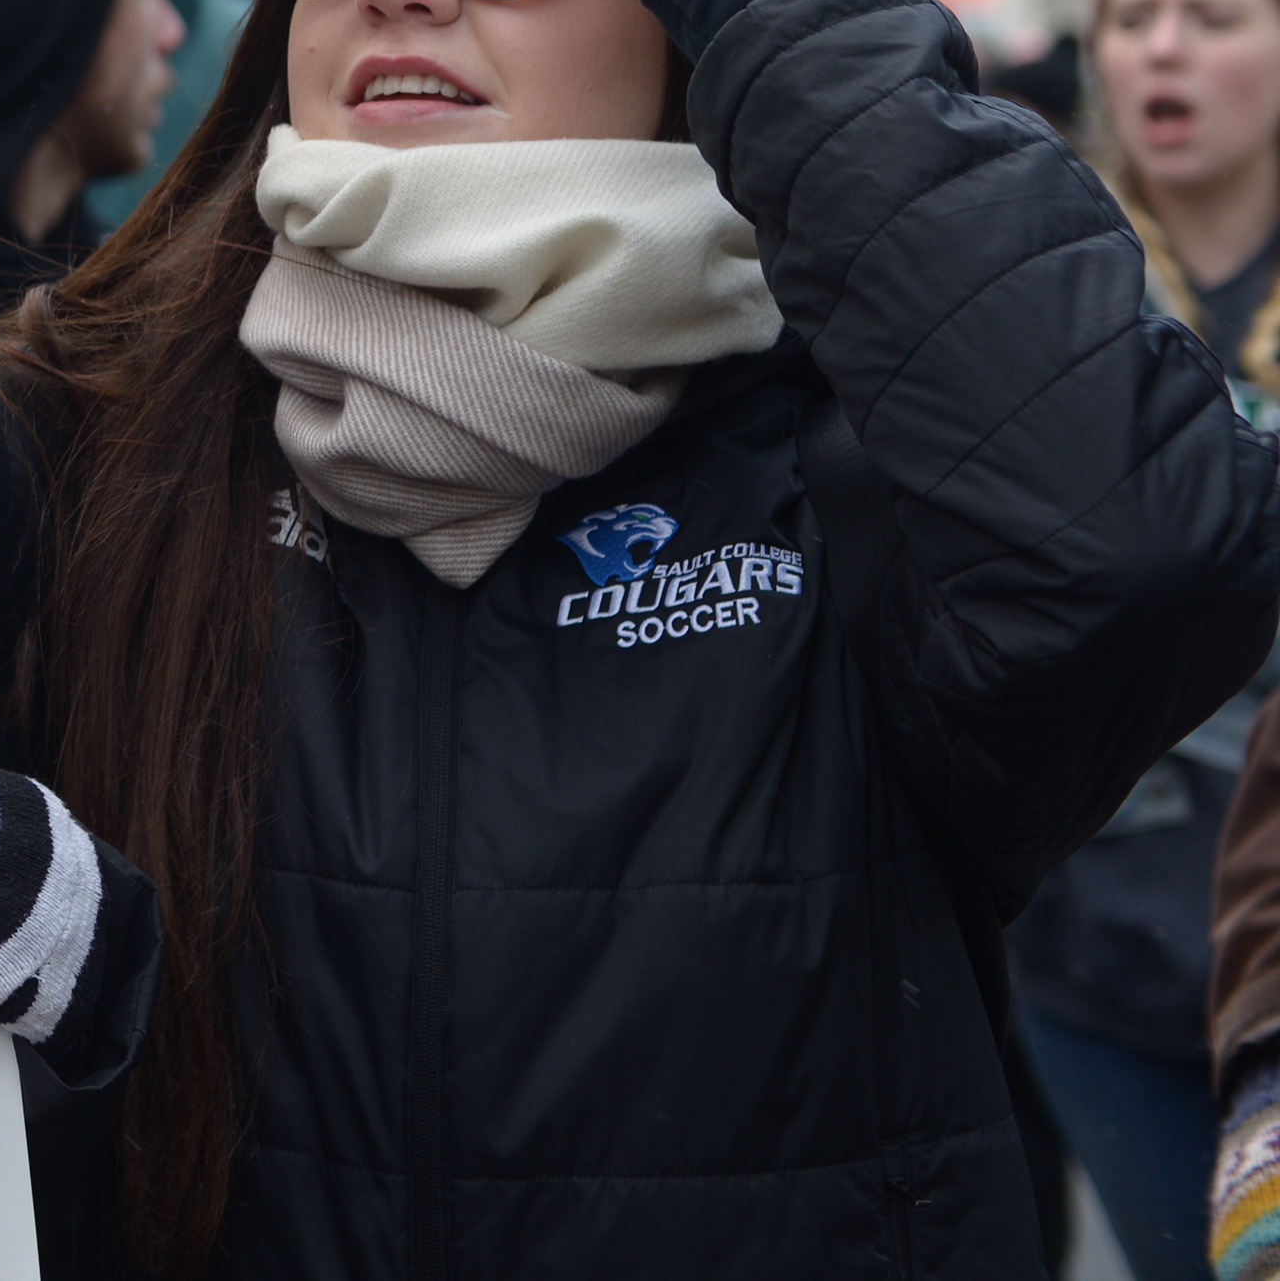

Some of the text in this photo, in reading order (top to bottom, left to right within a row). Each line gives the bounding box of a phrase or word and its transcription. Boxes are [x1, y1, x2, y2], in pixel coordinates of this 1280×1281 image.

[652, 542, 803, 579] SAULT COLLEGE
[556, 557, 804, 627] COUGARS
[617, 596, 761, 648] SOCCER
